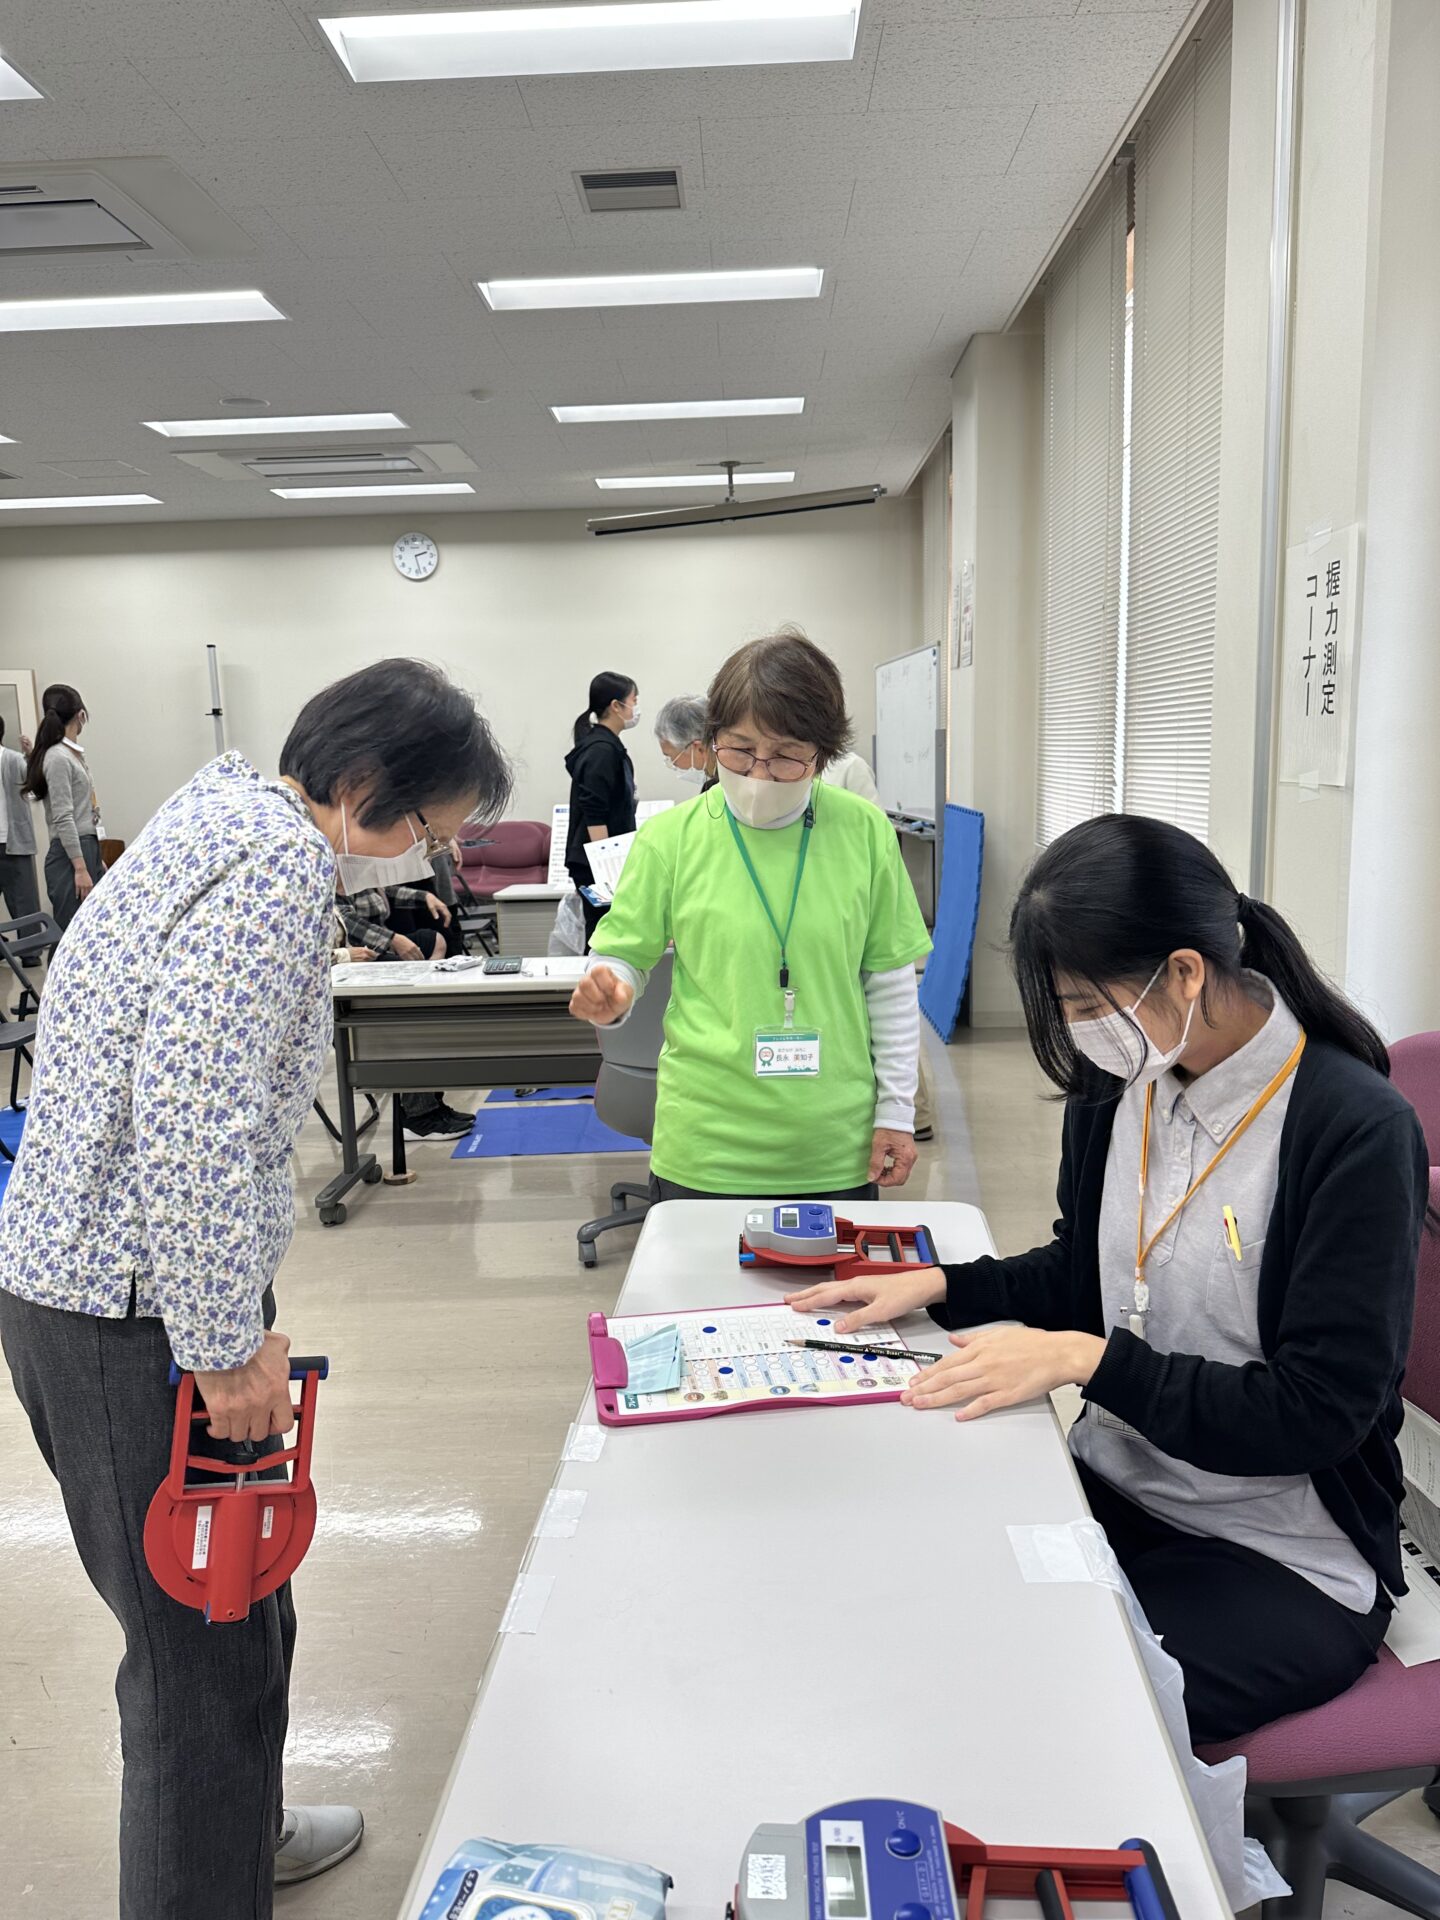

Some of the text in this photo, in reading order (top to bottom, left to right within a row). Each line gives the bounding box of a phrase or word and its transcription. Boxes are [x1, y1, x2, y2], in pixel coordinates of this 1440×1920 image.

[1303, 575, 1318, 717] コーナー
[1321, 560, 1341, 716] 握力測定
